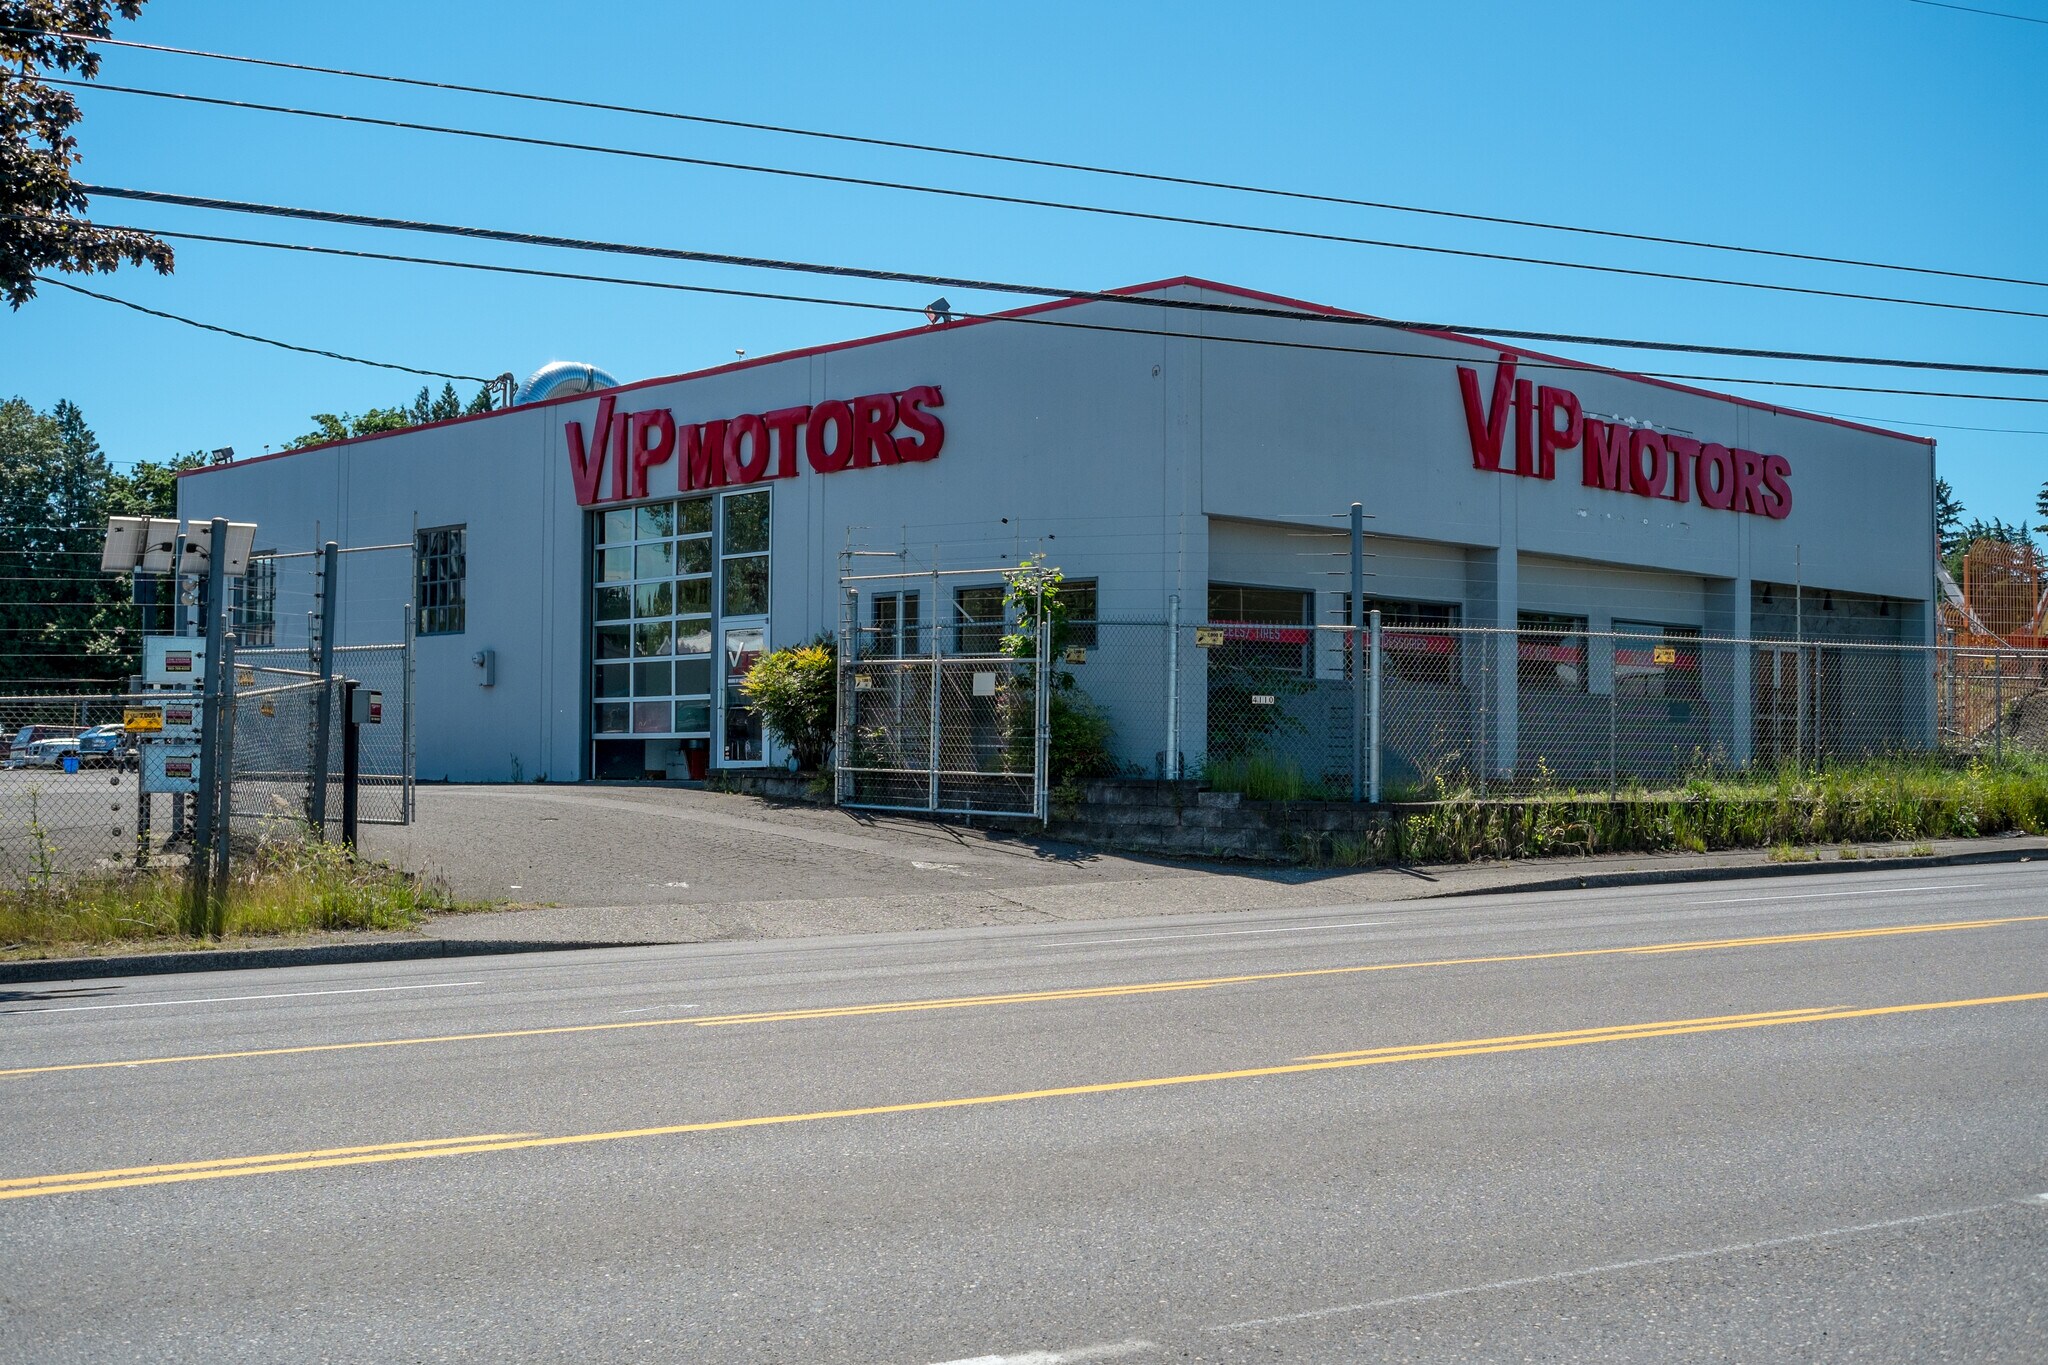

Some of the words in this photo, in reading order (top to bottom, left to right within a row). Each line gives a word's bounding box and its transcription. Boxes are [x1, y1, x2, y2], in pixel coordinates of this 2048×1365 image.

[565, 395, 676, 504] VIP
[679, 385, 945, 492] MOTORS
[1456, 353, 1583, 480] VIP
[1581, 417, 1792, 519] MOTORS
[1252, 696, 1274, 704] 4110
